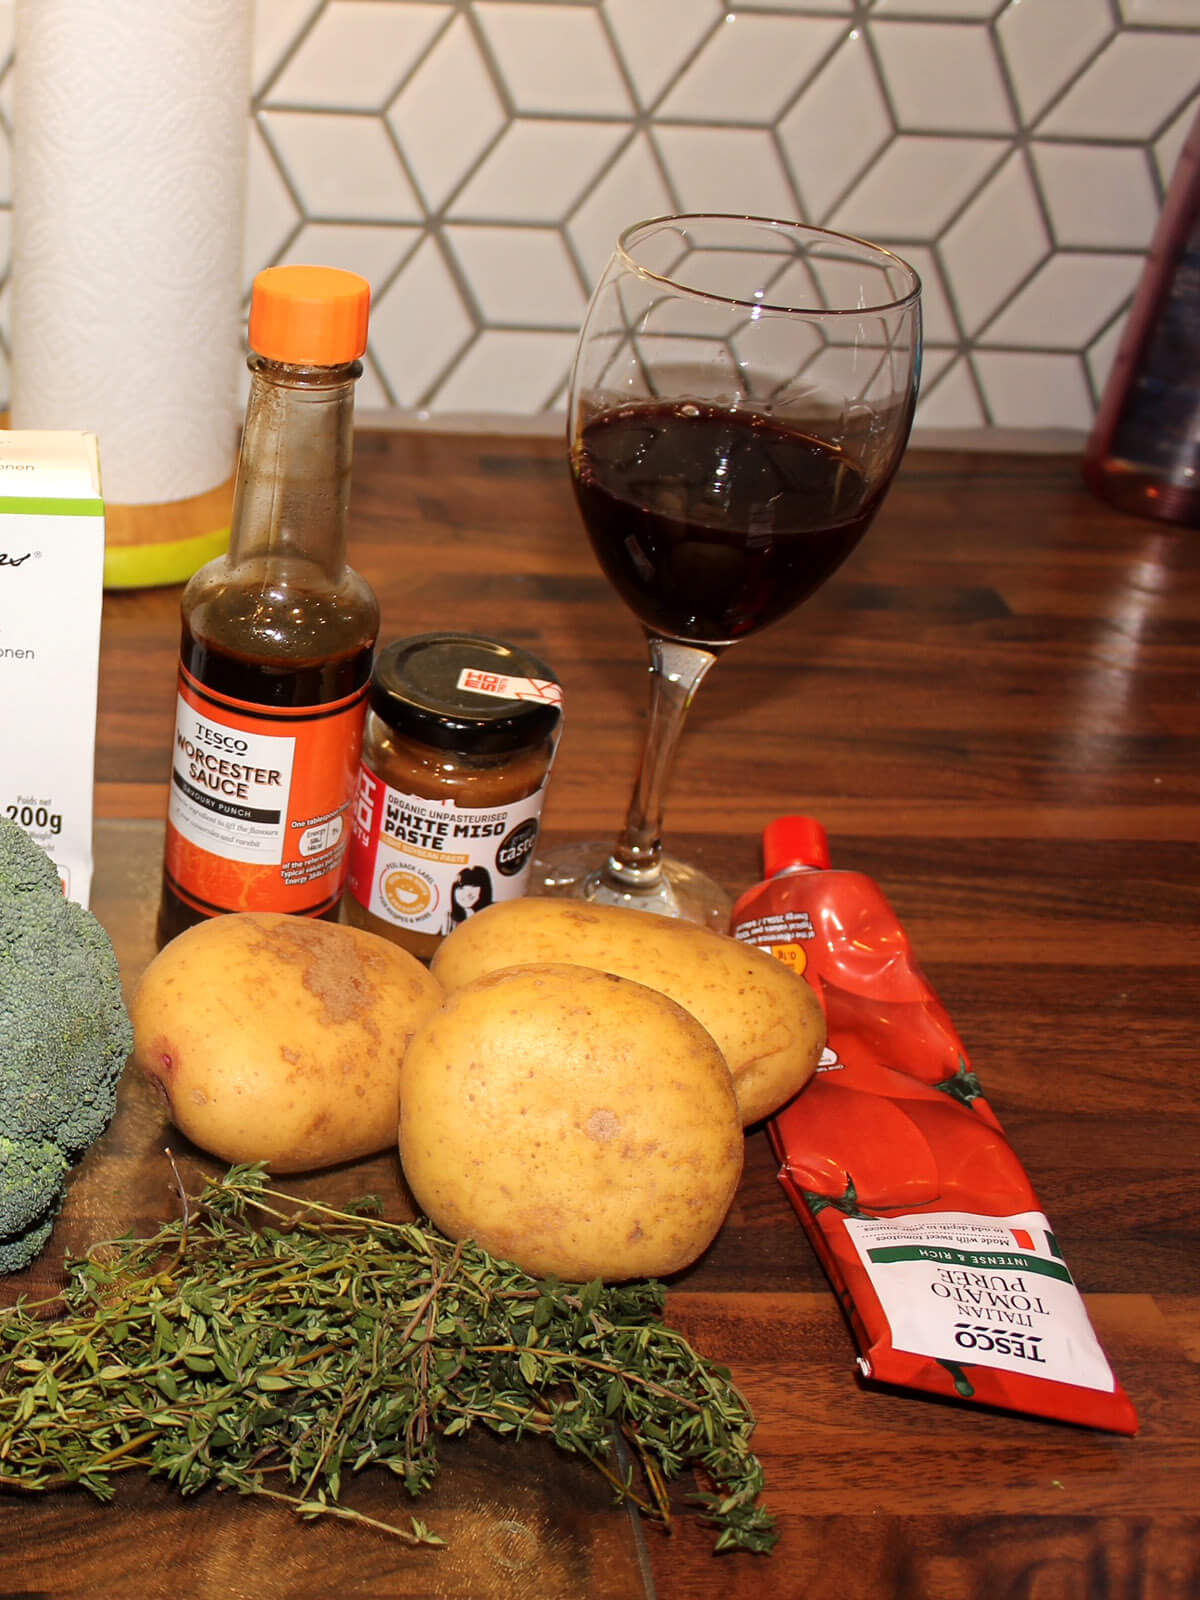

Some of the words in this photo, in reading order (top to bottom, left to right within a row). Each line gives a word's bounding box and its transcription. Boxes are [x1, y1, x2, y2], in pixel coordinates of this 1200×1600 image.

[195, 721, 249, 752] TESCO
[176, 727, 282, 787] WORCESTER
[188, 762, 250, 801] SAUCE
[218, 803, 252, 818] PUNCH
[385, 804, 450, 837] WHITE
[453, 821, 506, 839] MISO
[387, 794, 427, 816] ORGANIC
[429, 809, 509, 824] UNPASTEURISED
[384, 819, 445, 851] PASTE
[925, 1233, 953, 1241] sweet
[956, 1236, 978, 1245] with
[980, 1237, 1010, 1247] Made
[919, 1249, 952, 1260] RICH
[957, 1253, 965, 1262] &
[971, 1255, 1029, 1268] INTENSE
[936, 1268, 1028, 1293] PURÉE
[930, 1282, 1050, 1316] TOMATO
[957, 1302, 1033, 1328] ITALIAN
[954, 1331, 1047, 1363] TESCO
